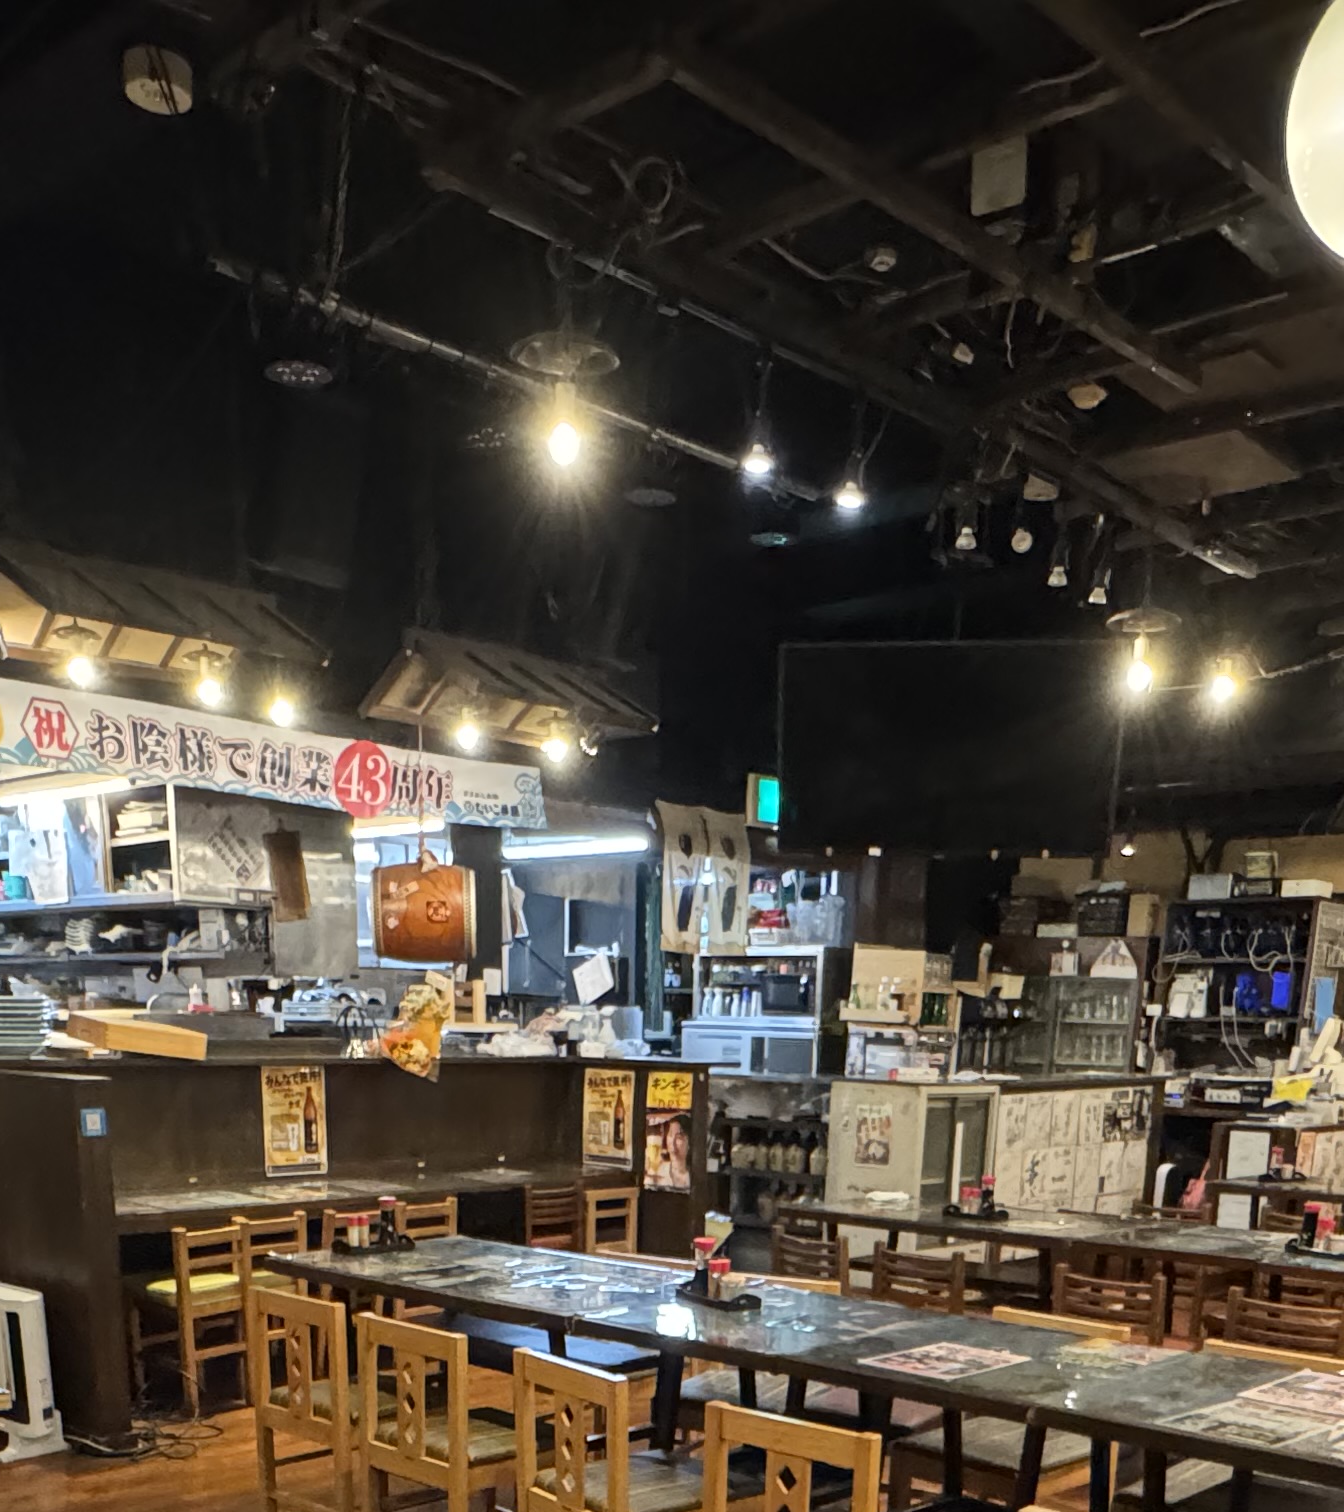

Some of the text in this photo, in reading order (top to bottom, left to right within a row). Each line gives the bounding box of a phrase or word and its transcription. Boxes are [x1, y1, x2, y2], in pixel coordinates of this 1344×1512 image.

[32, 705, 72, 752] 祝
[651, 1077, 690, 1092] キンキン
